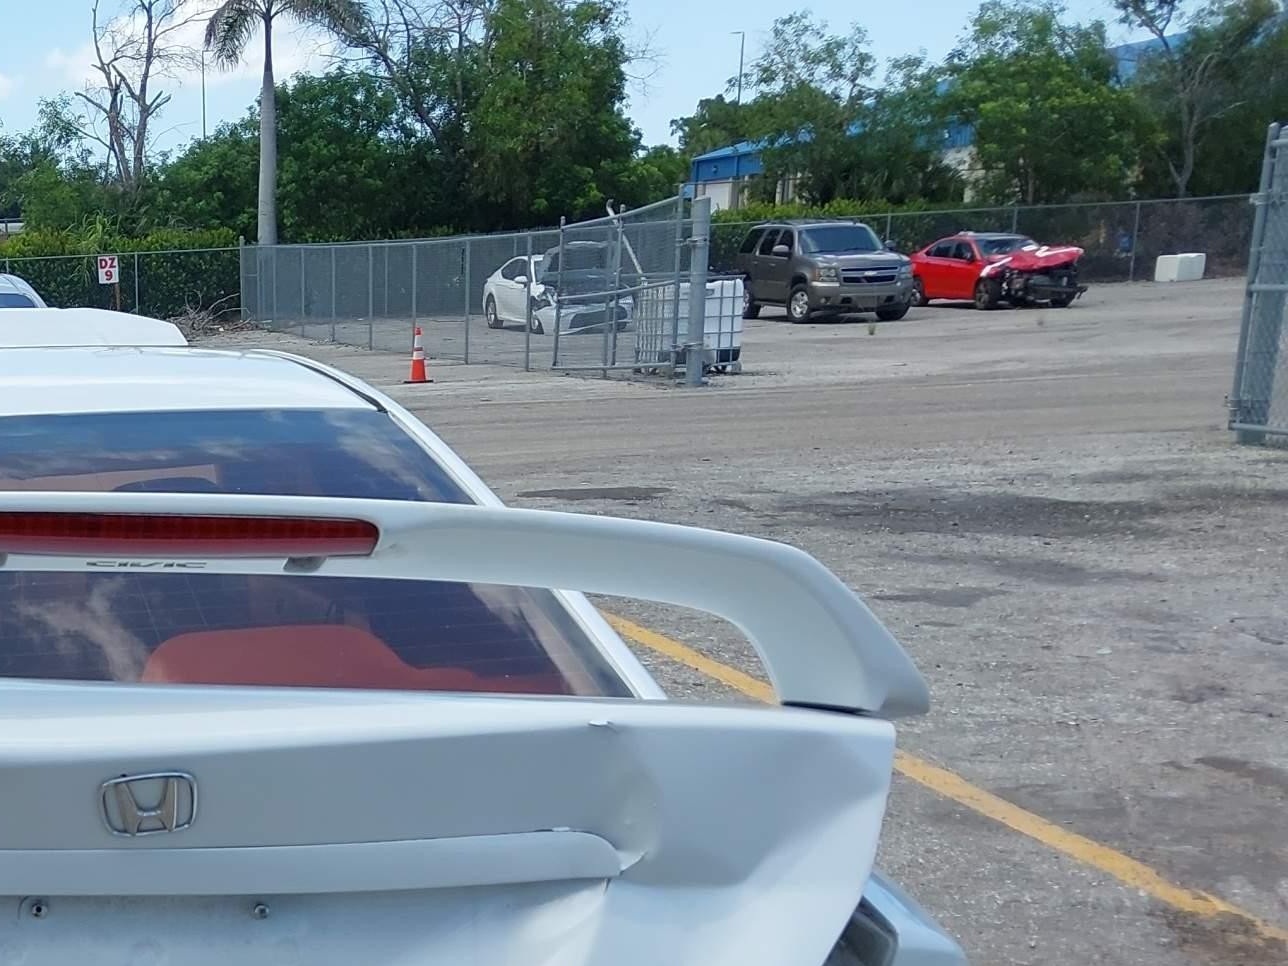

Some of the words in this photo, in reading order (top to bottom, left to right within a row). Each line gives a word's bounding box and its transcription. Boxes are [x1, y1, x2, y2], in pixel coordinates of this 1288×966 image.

[99, 257, 116, 269] DZ
[104, 270, 113, 281] 9
[86, 560, 207, 569] CIVIC
